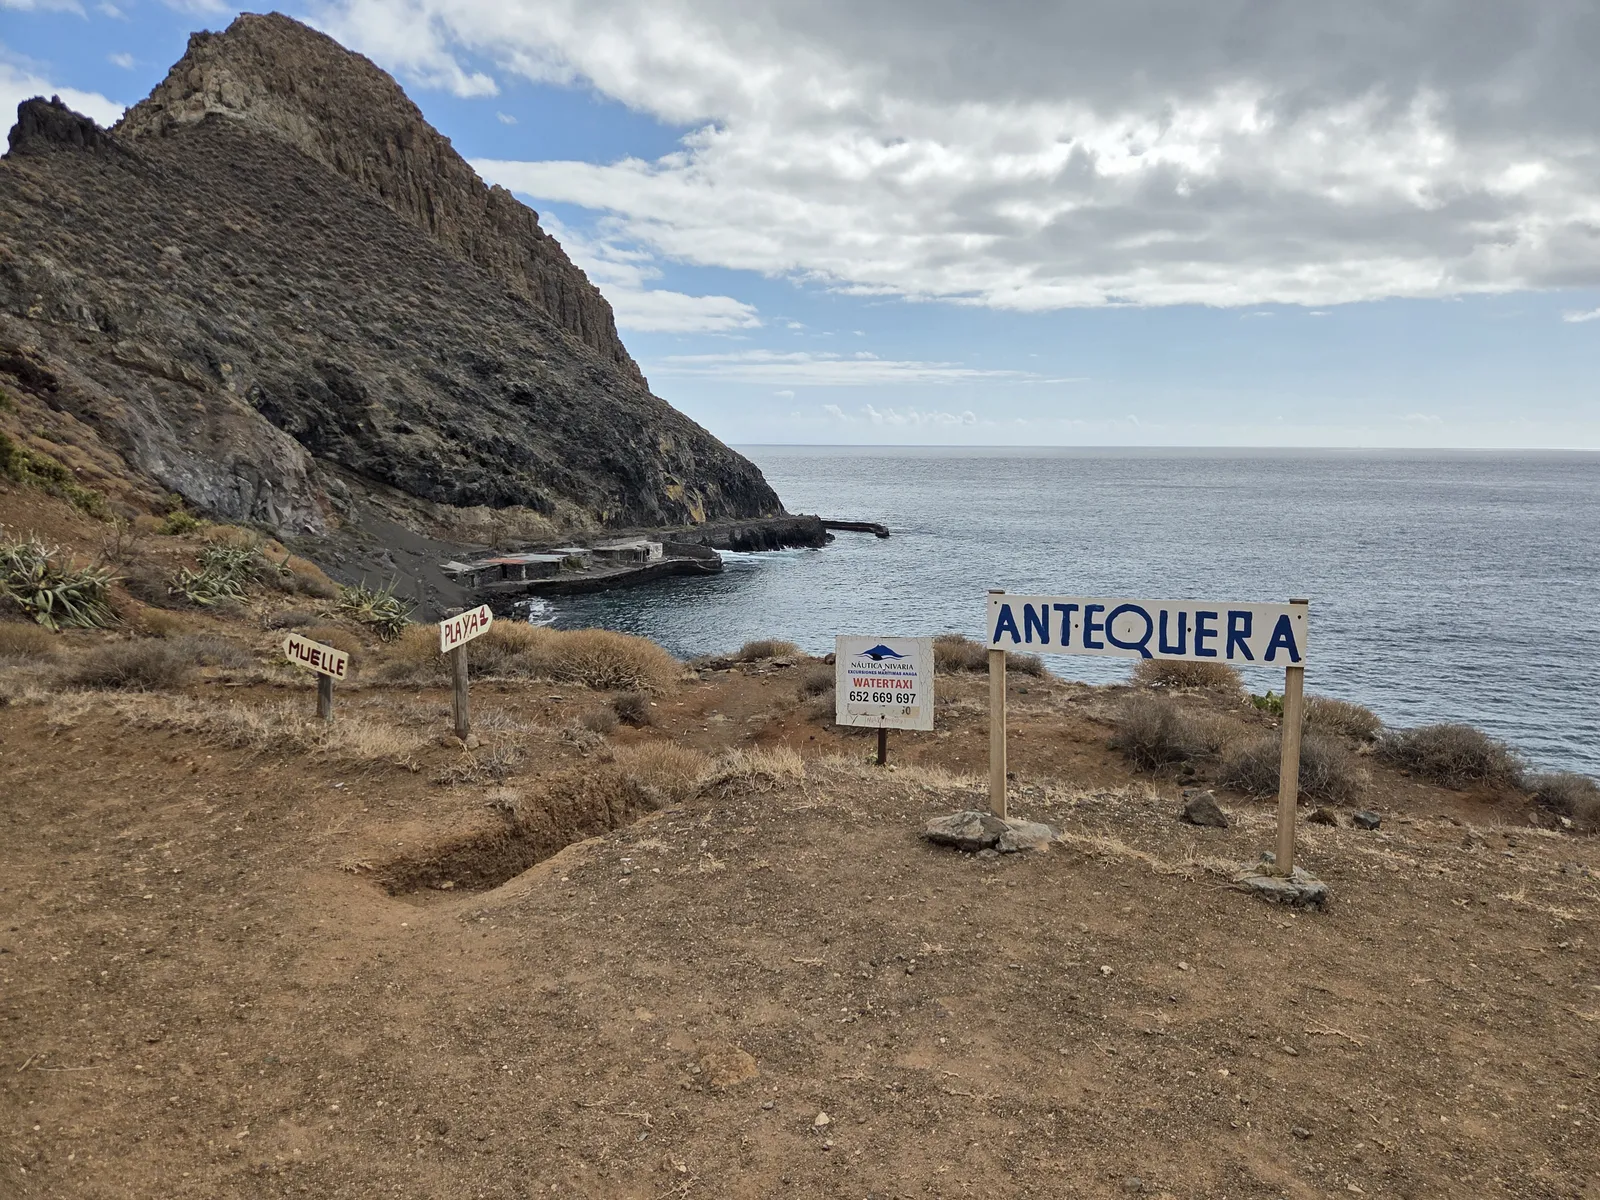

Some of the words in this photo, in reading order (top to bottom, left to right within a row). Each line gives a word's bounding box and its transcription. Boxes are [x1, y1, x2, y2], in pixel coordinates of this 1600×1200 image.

[445, 613, 478, 645] PLAYA
[993, 604, 1301, 662] ANTEQUERA
[289, 640, 345, 676] MUELLE
[851, 661, 882, 669] NÁUTICA
[853, 678, 912, 689] WATERTAXI
[849, 691, 869, 702] 652
[873, 692, 892, 703] 669
[896, 693, 916, 704] 697
